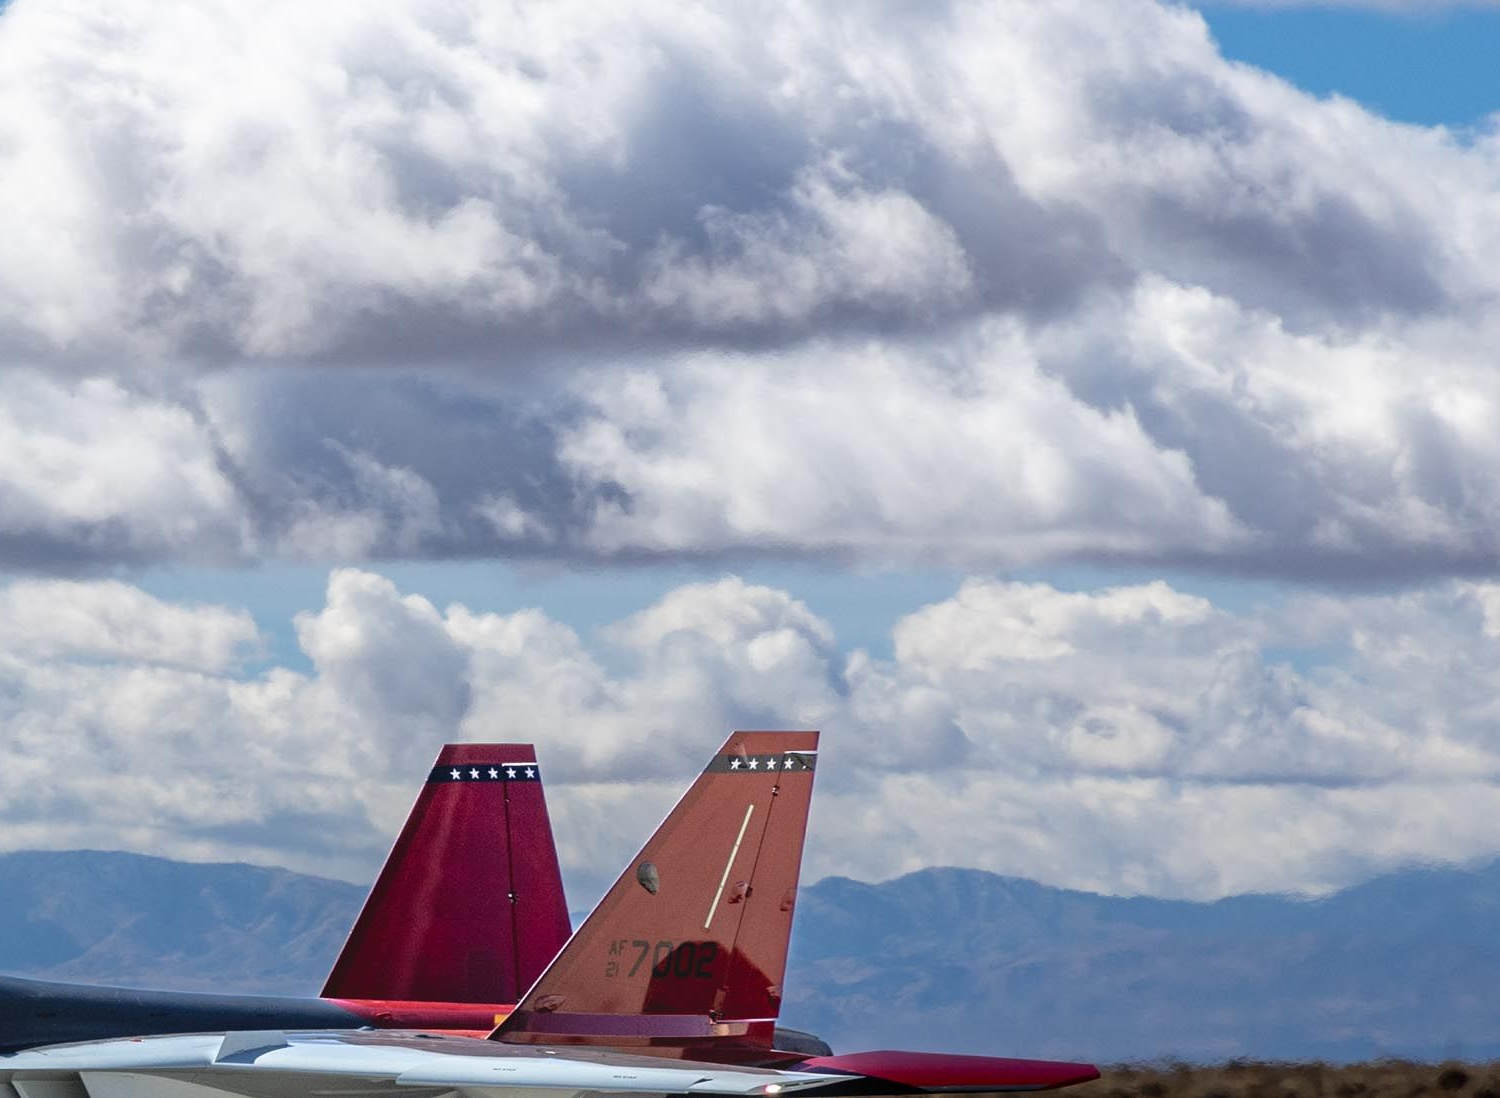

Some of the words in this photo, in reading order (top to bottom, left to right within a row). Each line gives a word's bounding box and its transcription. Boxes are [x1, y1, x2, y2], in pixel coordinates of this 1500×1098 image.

[608, 940, 628, 956] AF
[628, 940, 718, 978] 7002
[605, 961, 620, 978] 21
